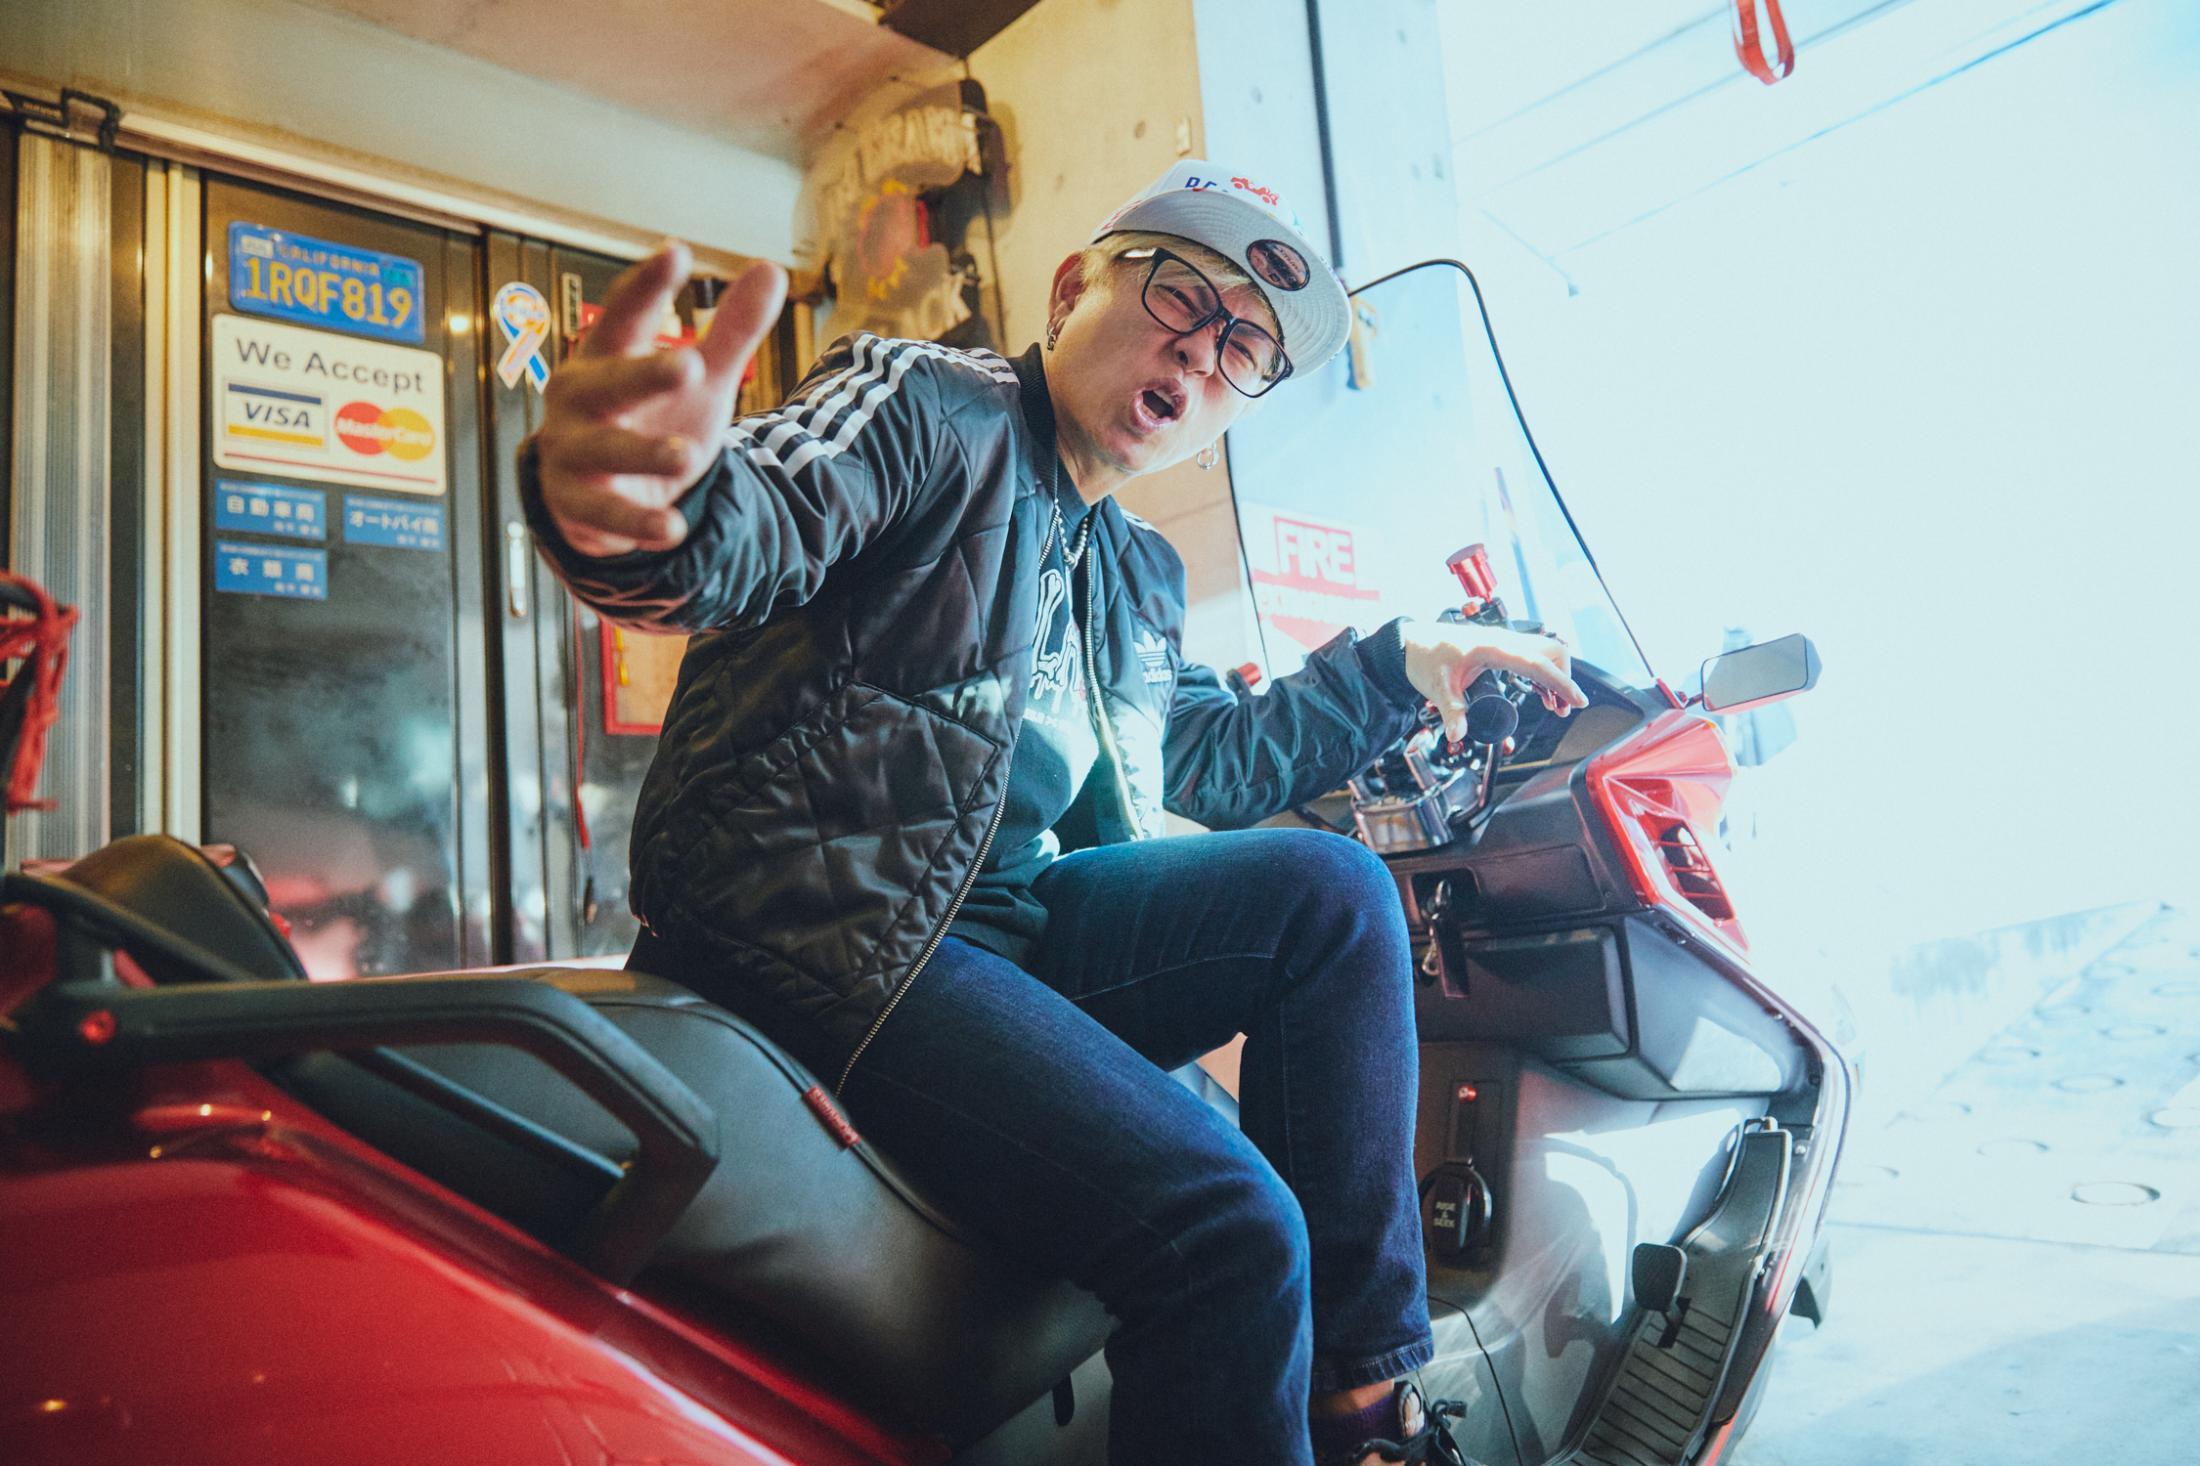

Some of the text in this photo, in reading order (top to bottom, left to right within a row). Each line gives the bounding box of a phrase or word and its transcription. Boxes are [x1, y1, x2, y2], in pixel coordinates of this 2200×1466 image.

[240, 257, 413, 329] 1RQF819
[236, 337, 423, 394] We Accept
[244, 402, 311, 429] VISA
[1278, 521, 1355, 585] FIRE
[1142, 667, 1174, 684] adidas
